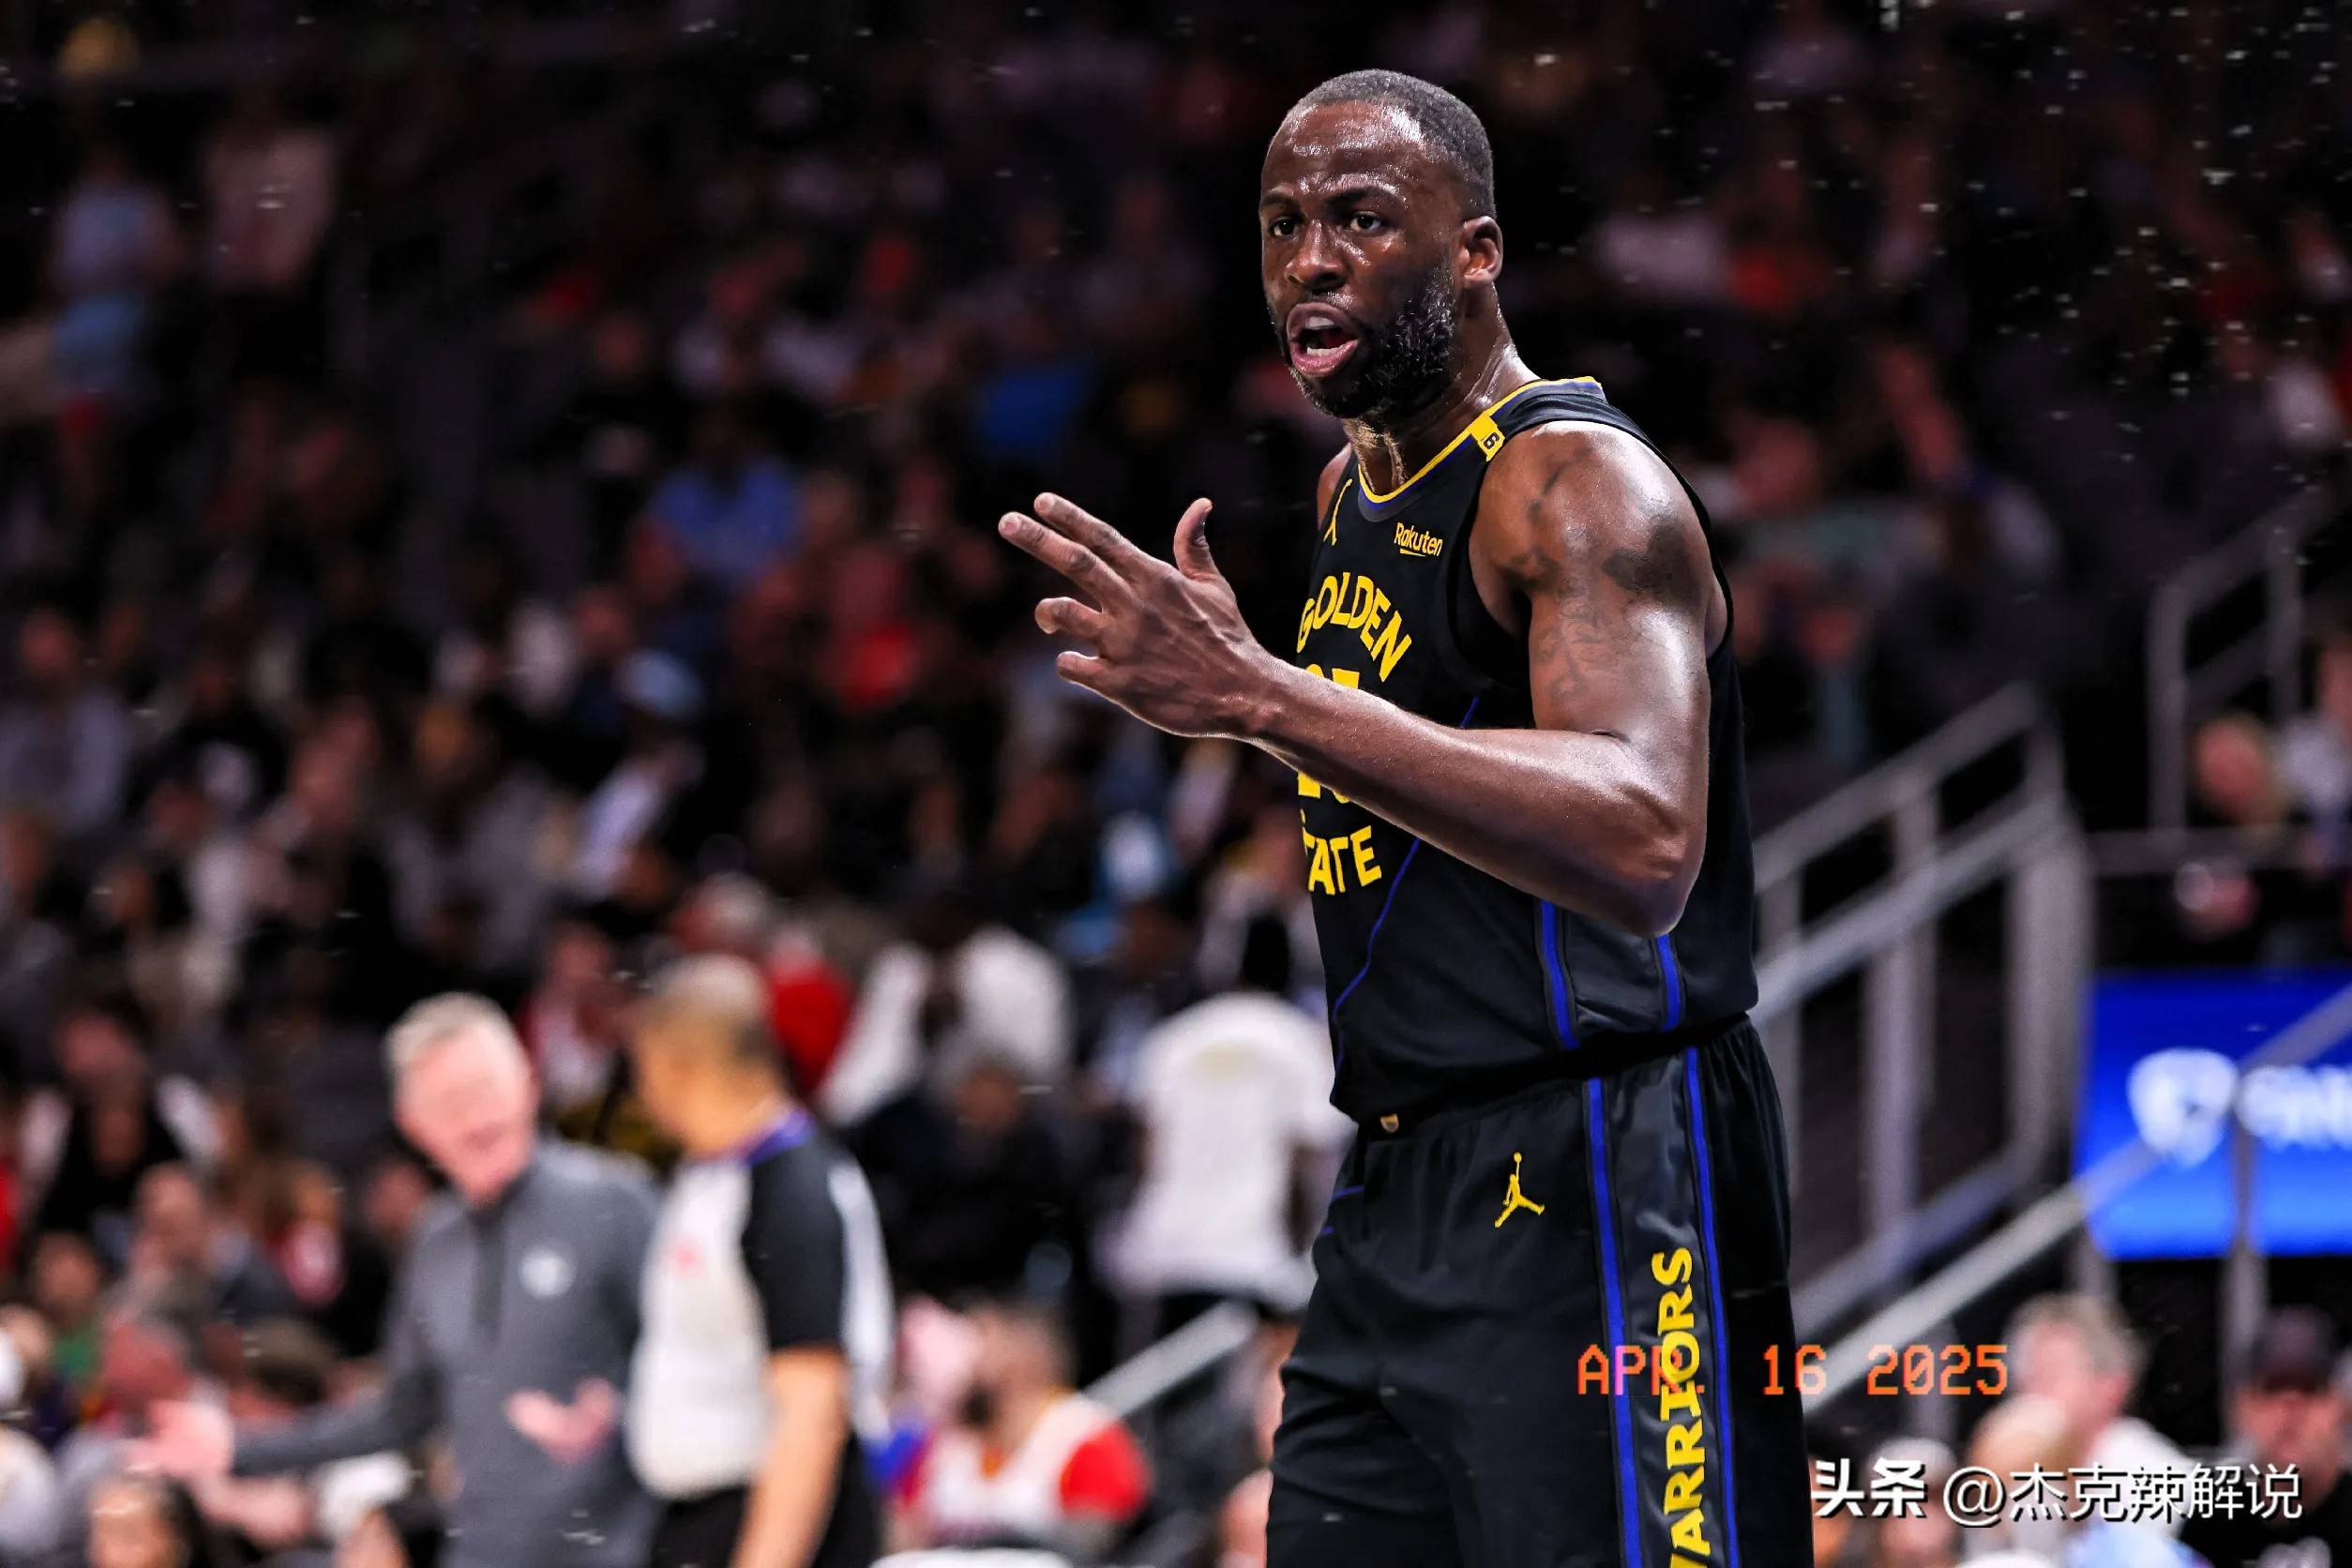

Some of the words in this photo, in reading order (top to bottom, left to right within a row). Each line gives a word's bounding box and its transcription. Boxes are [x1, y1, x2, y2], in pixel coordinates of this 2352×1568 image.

[1394, 521, 1443, 557] Rakuten
[1296, 571, 1412, 690] GOLDEN
[1300, 824, 1382, 896] ATE
[1651, 1247, 1711, 1568] ARRIORS
